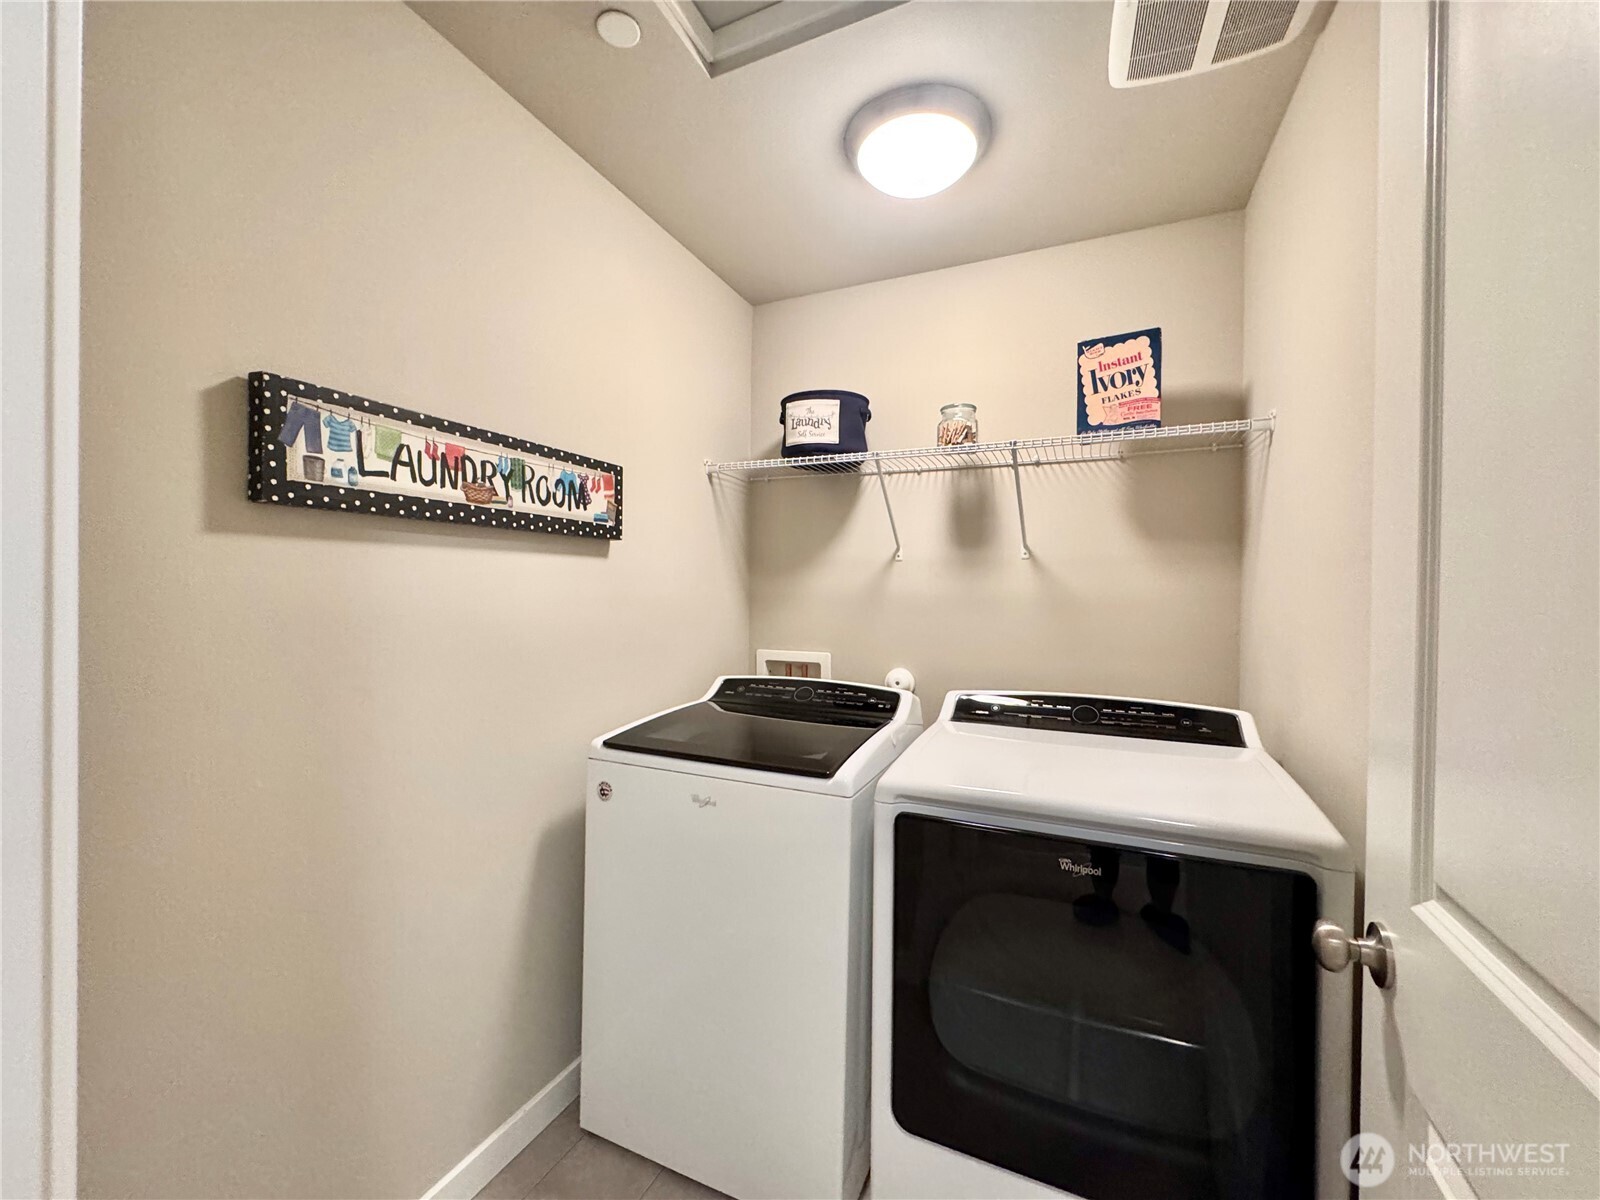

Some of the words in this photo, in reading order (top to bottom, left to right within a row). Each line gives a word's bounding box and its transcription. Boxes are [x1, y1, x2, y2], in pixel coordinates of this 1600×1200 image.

[1098, 352, 1143, 372] Instant
[1088, 363, 1149, 395] Ivory
[1101, 388, 1142, 404] FLAKES
[791, 416, 832, 430] Laundry
[357, 429, 513, 501] LAUNDRY
[521, 464, 588, 511] ROOM
[1060, 860, 1102, 876] Whirlpool
